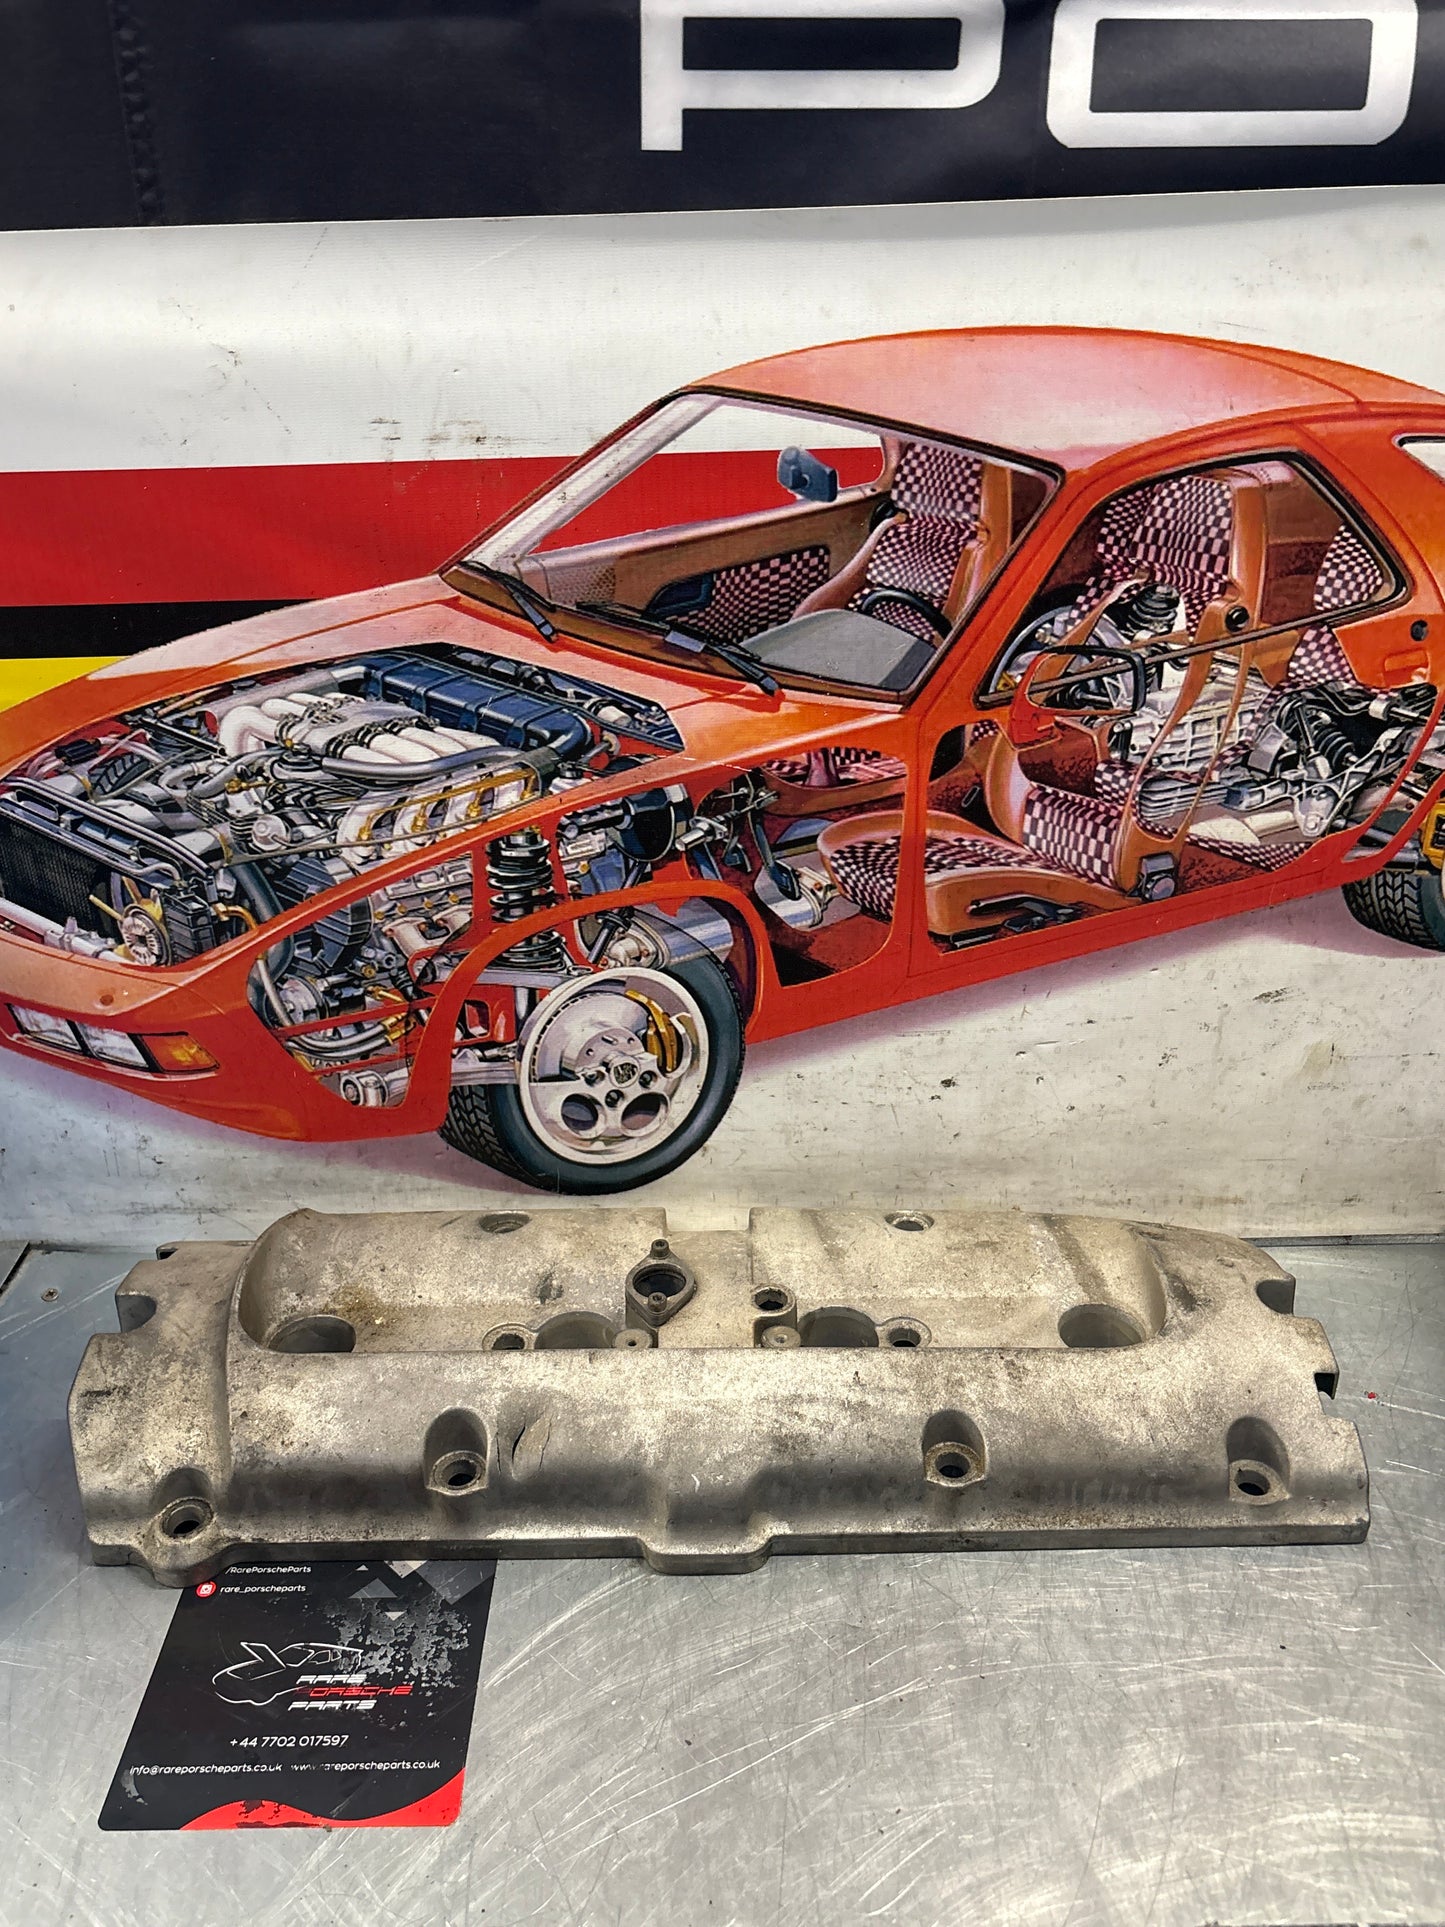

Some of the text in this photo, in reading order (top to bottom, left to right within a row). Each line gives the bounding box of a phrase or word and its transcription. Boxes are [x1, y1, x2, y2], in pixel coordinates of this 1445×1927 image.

[225, 1566, 312, 1574] /RarePorscheParts
[220, 1585, 306, 1593] rare_porscheparts
[296, 1674, 367, 1684] RARE
[288, 1700, 377, 1710] PARTS
[230, 1735, 349, 1747] +44 7702 017597
[130, 1763, 282, 1775] info@rareporscheparts.co.uk
